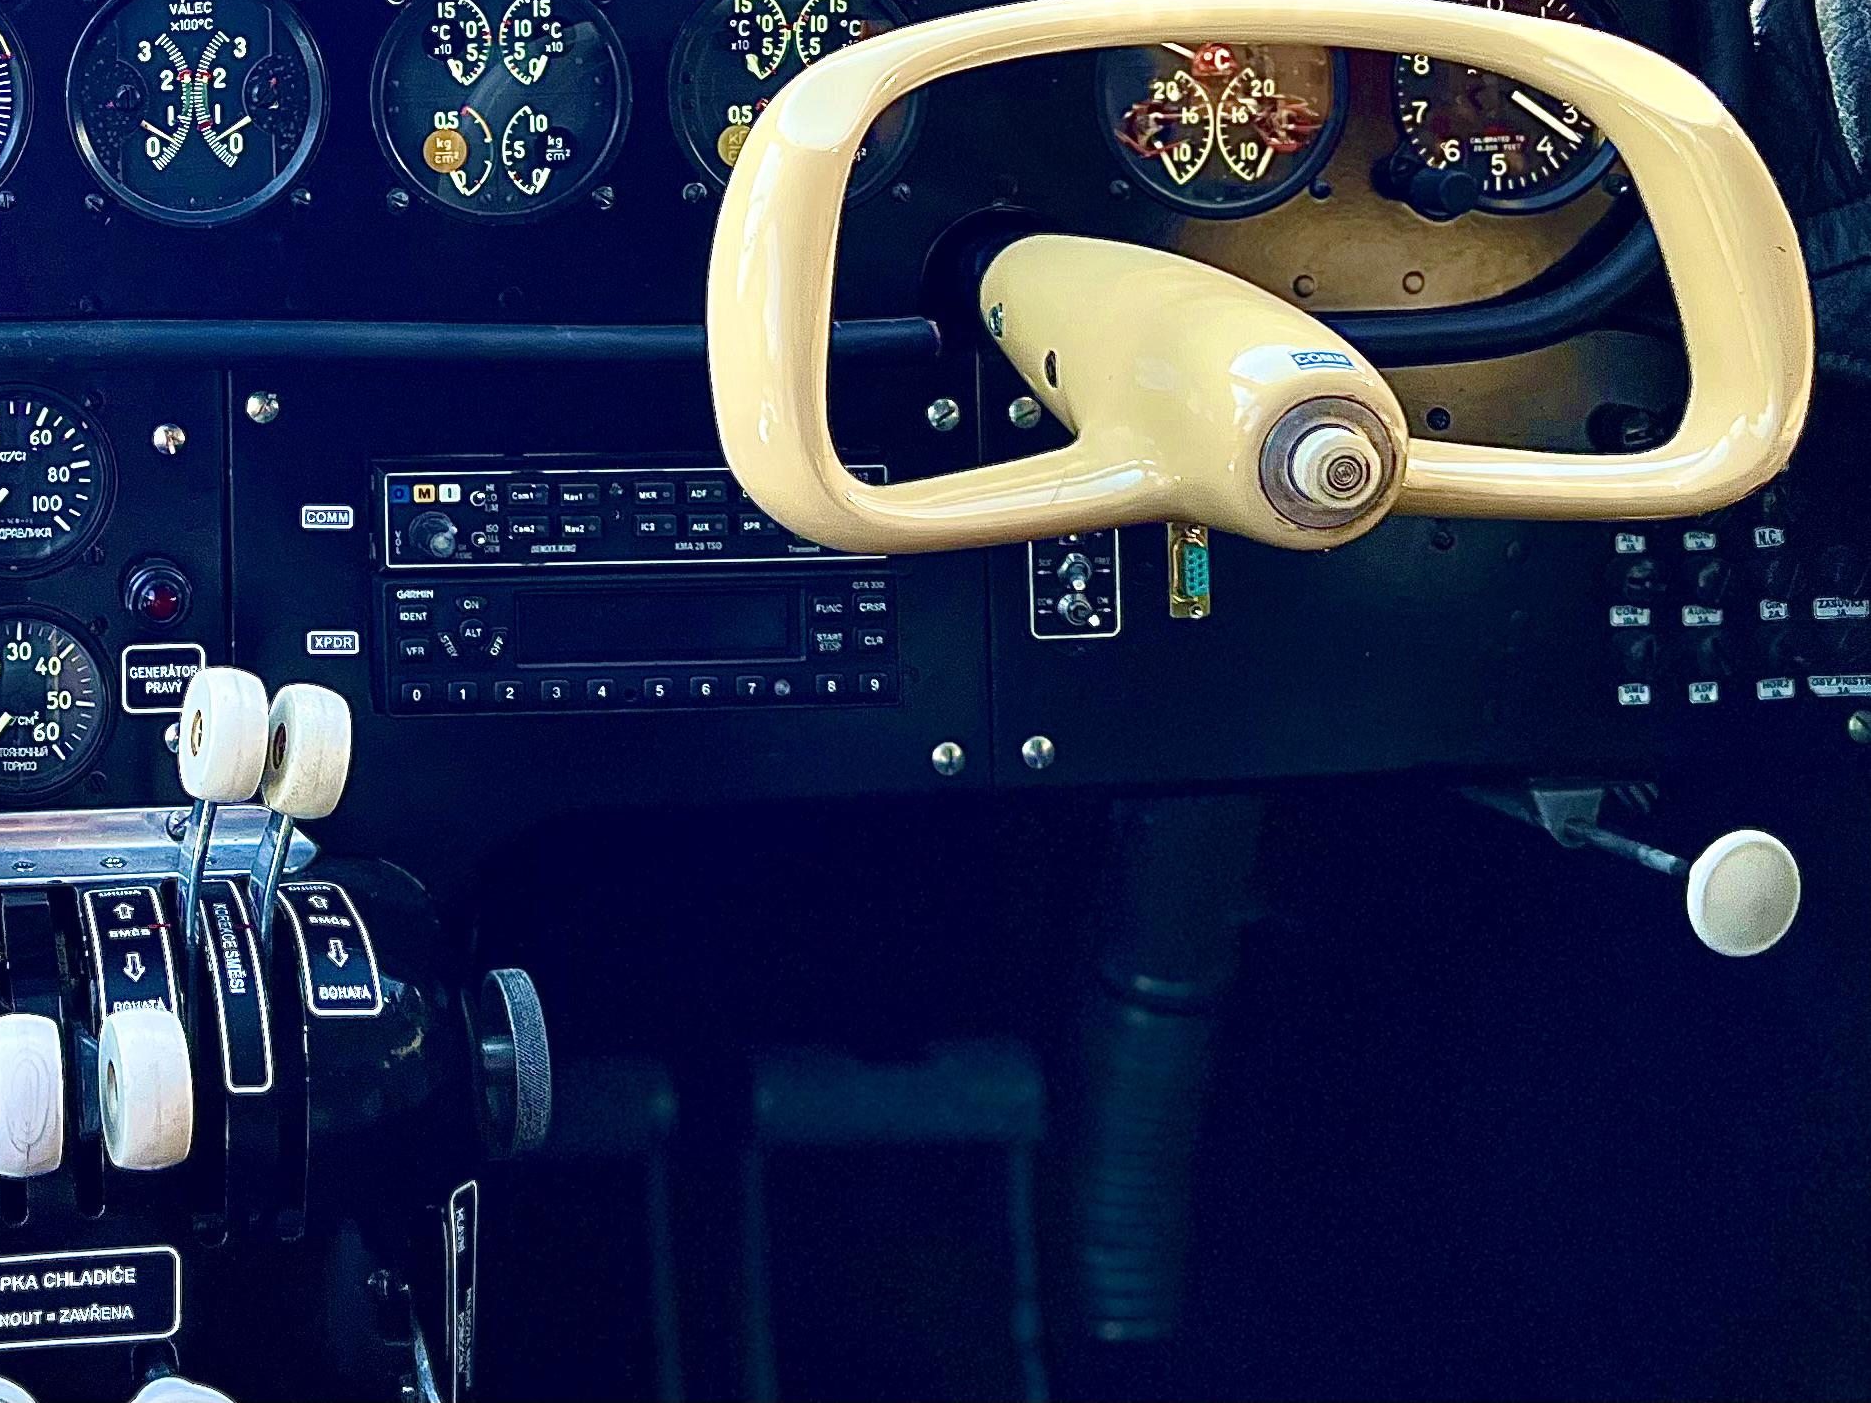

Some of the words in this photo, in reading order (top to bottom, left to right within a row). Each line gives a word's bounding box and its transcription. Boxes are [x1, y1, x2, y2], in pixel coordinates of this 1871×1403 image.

[532, 0, 551, 17] 15
[46, 466, 71, 483] 80
[32, 495, 64, 512] 100
[304, 510, 349, 524] COMM
[463, 600, 479, 610] ON
[858, 602, 887, 612] CRSR
[399, 612, 428, 622] IDENT
[464, 628, 482, 638] ALT
[314, 635, 354, 649] XPDR
[5, 642, 33, 662] 30
[405, 647, 425, 656] VFR
[145, 679, 183, 695] PRAVÝ
[46, 691, 72, 710] 50
[42, 1265, 137, 1288] CHLADIČE
[59, 1303, 134, 1323] ZAVŘENA
